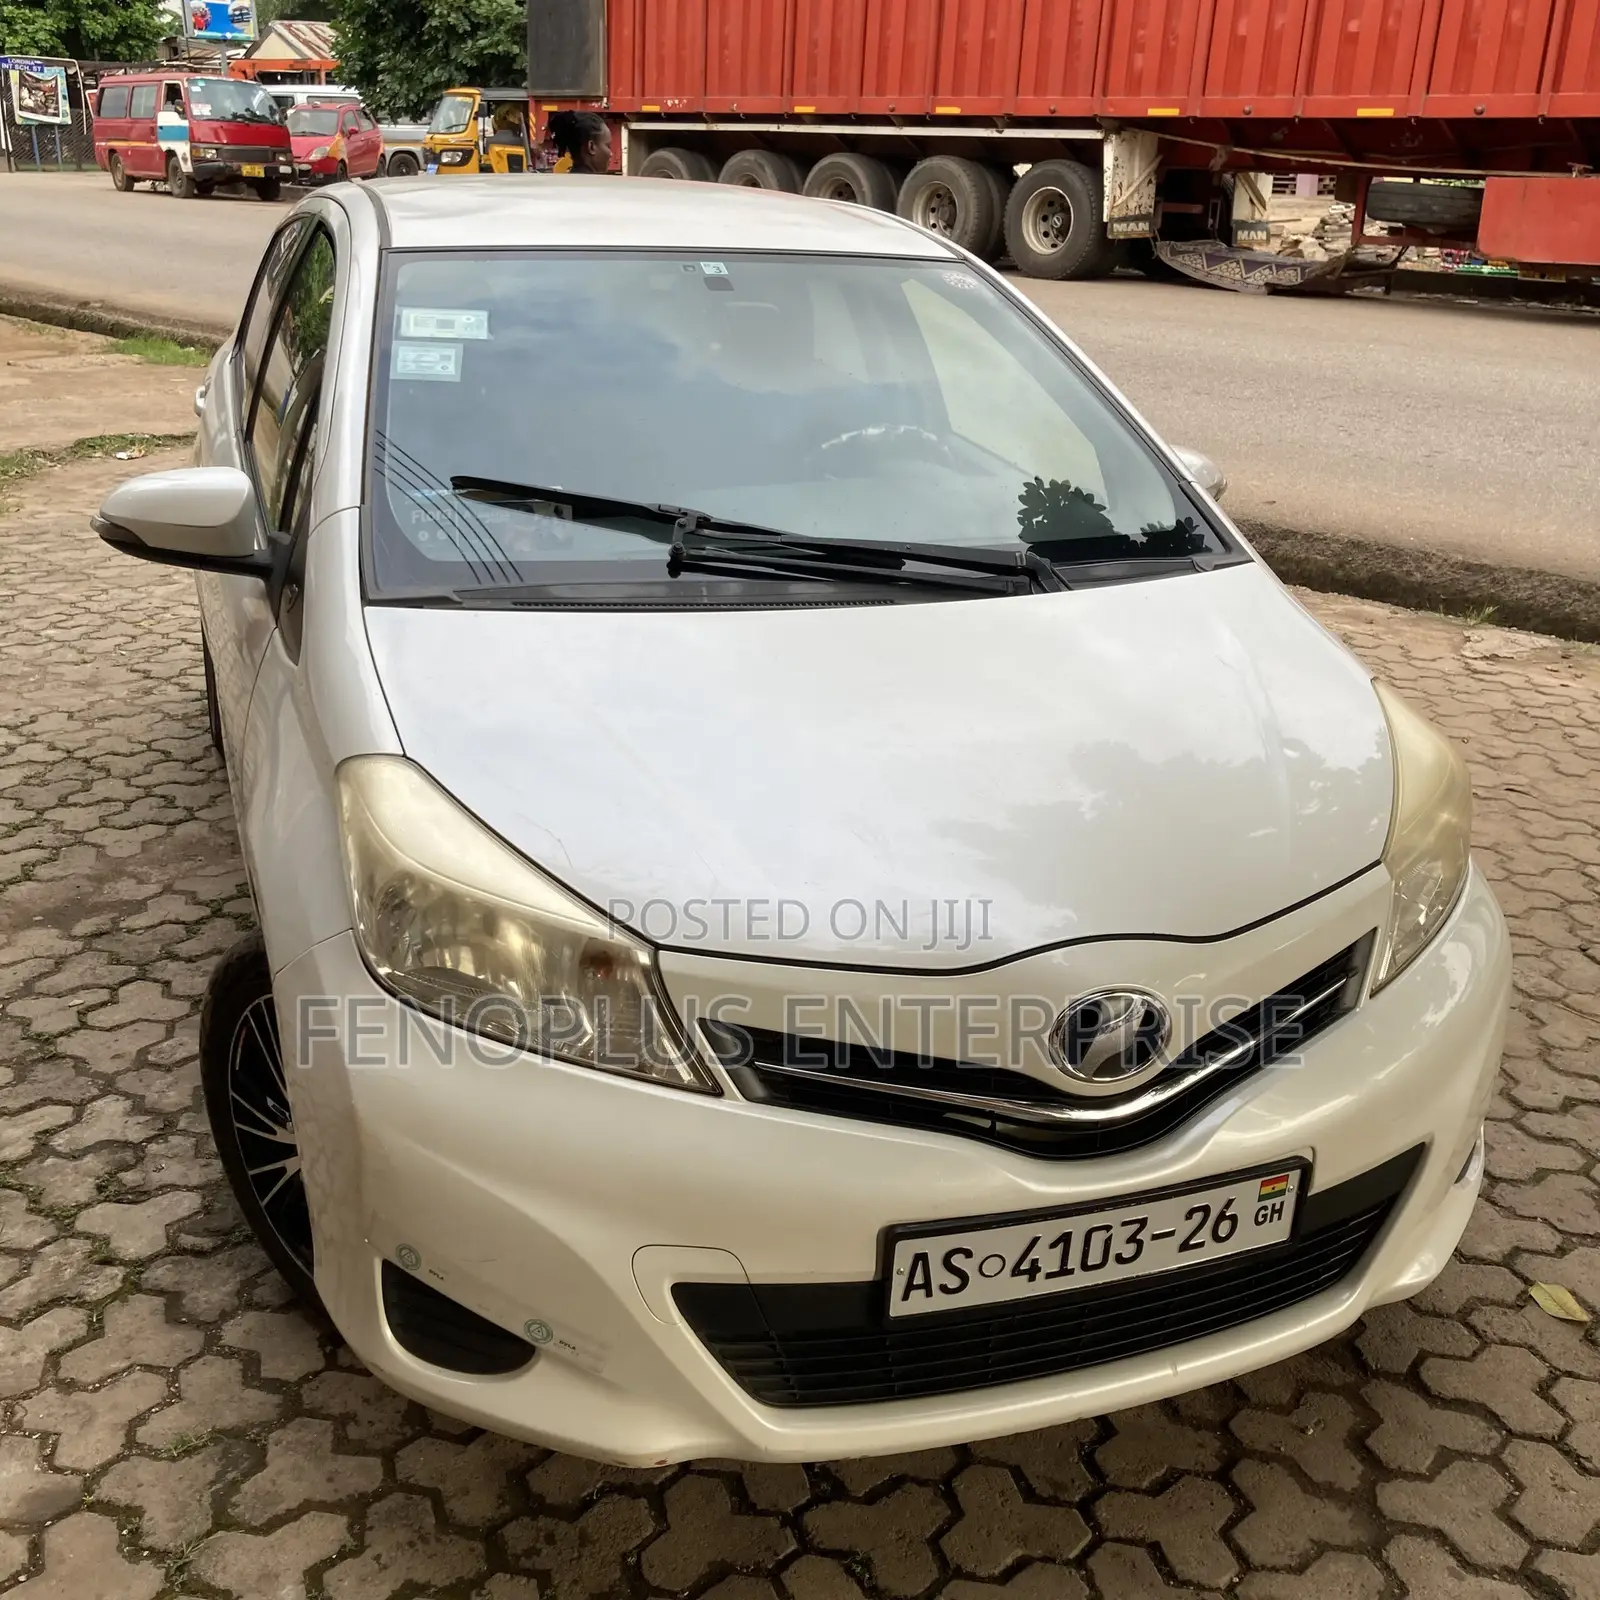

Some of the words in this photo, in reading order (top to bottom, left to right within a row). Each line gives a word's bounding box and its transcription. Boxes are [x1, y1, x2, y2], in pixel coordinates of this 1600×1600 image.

[1113, 222, 1150, 232] MAN
[1237, 230, 1267, 240] MAN
[1253, 1200, 1285, 1227] GH
[901, 1246, 973, 1302] AS
[1010, 1196, 1239, 1283] 4103-26
